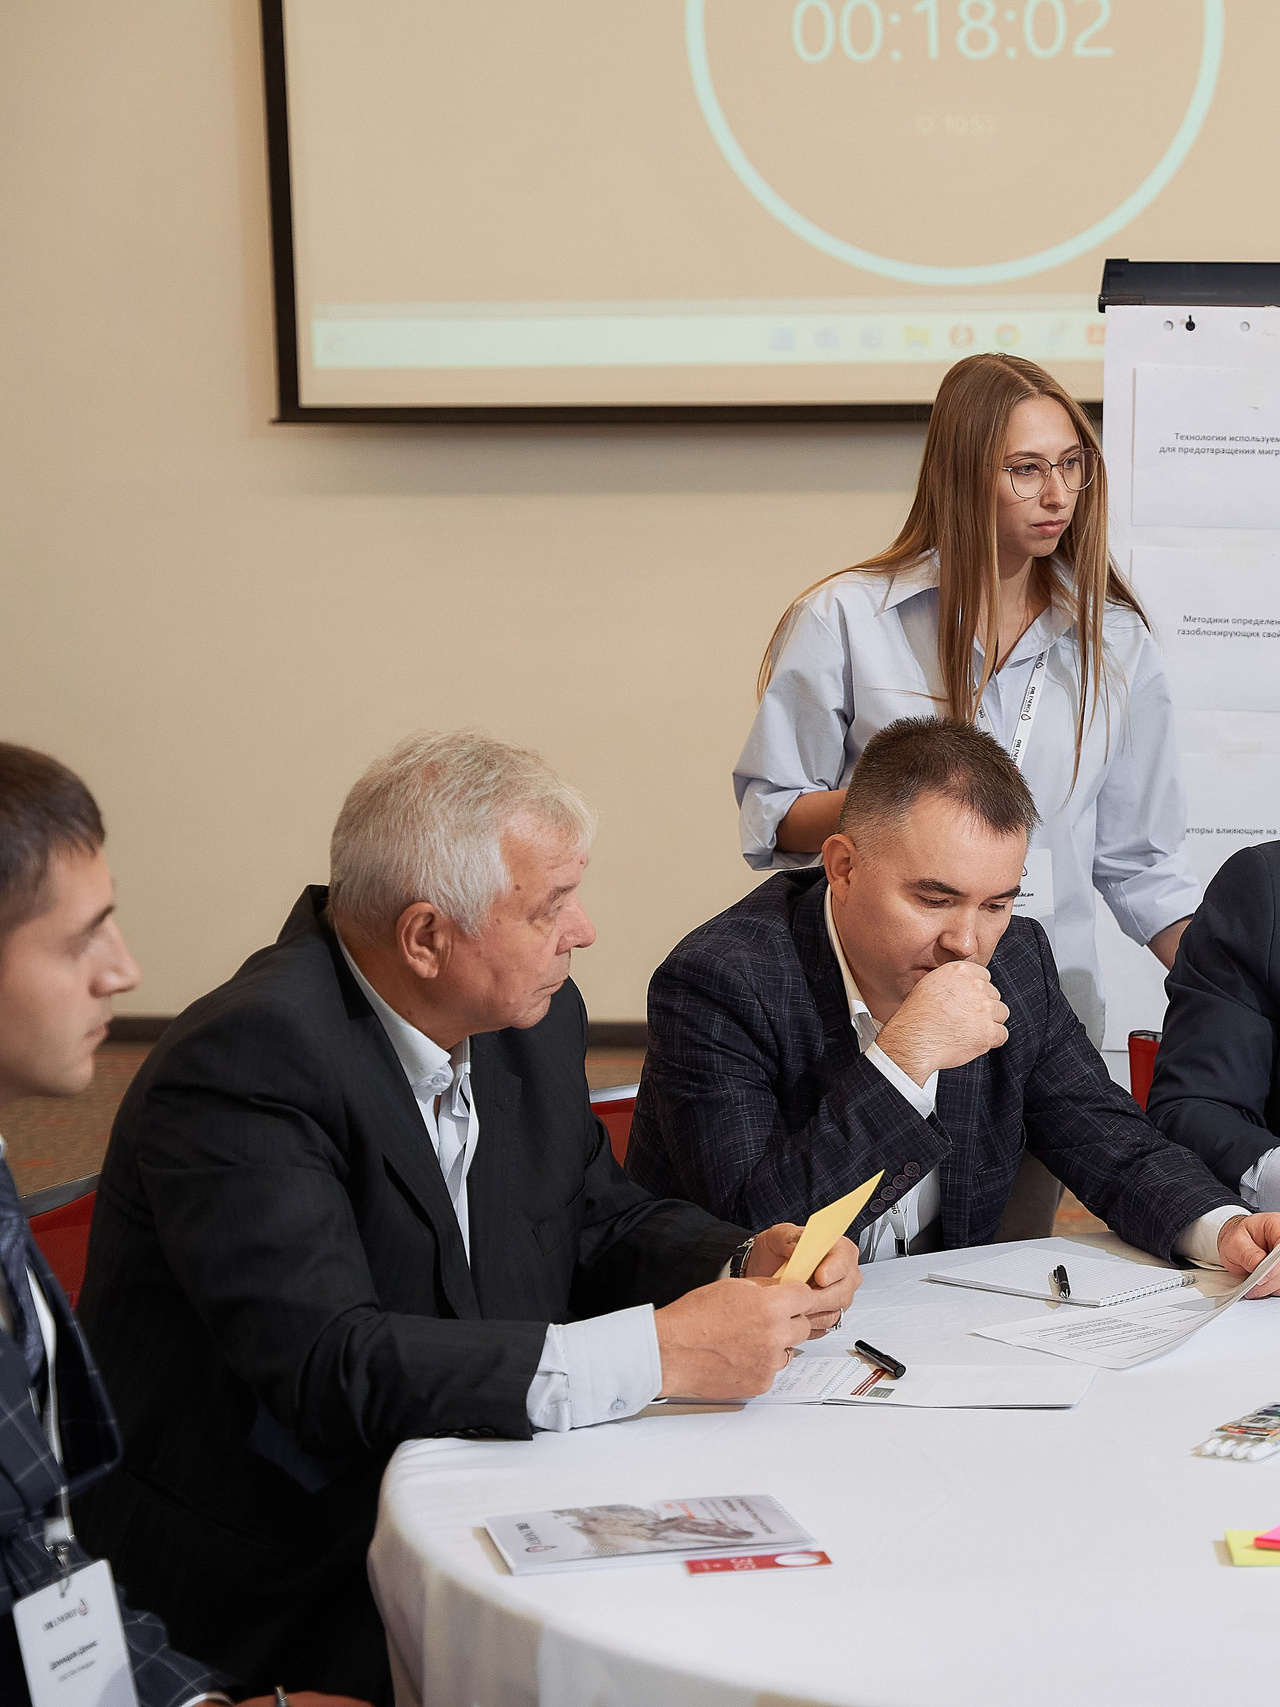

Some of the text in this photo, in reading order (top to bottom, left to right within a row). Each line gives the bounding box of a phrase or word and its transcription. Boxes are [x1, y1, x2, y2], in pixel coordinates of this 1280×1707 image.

[792, 0, 1114, 63] 00:18:02
[1174, 432, 1227, 443] Технологии
[1159, 446, 1176, 454] для
[1178, 446, 1255, 456] предотвращения
[1182, 615, 1229, 625] Методики
[1177, 628, 1260, 638] газоблокирующих
[1024, 695, 1034, 713] ENERGY
[1185, 827, 1213, 836] кторы
[1215, 827, 1264, 836] влияющие
